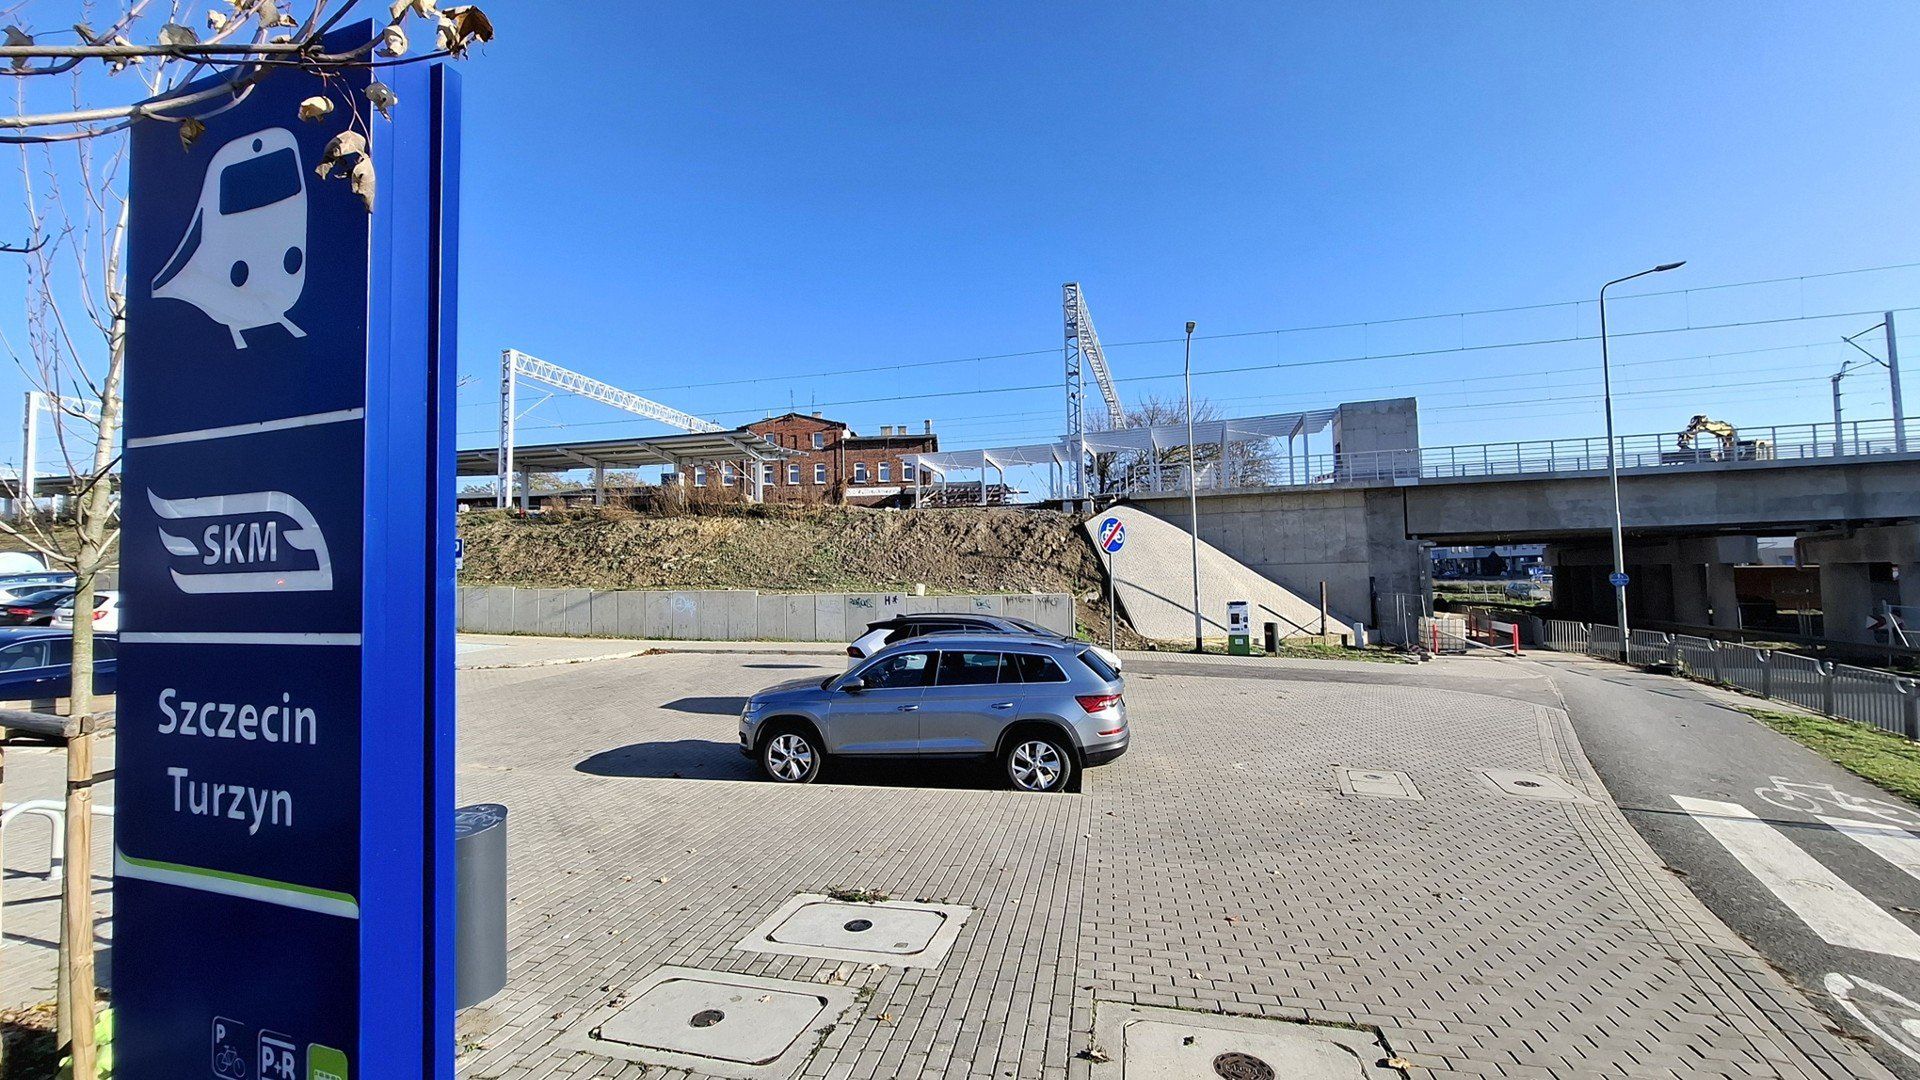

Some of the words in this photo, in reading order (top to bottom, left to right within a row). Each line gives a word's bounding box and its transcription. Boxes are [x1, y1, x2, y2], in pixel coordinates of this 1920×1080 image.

[203, 521, 277, 565] SKM
[158, 688, 317, 745] Szczecin
[167, 767, 293, 836] Turzyn
[216, 1024, 226, 1044] P
[262, 1046, 296, 1080] P+R
